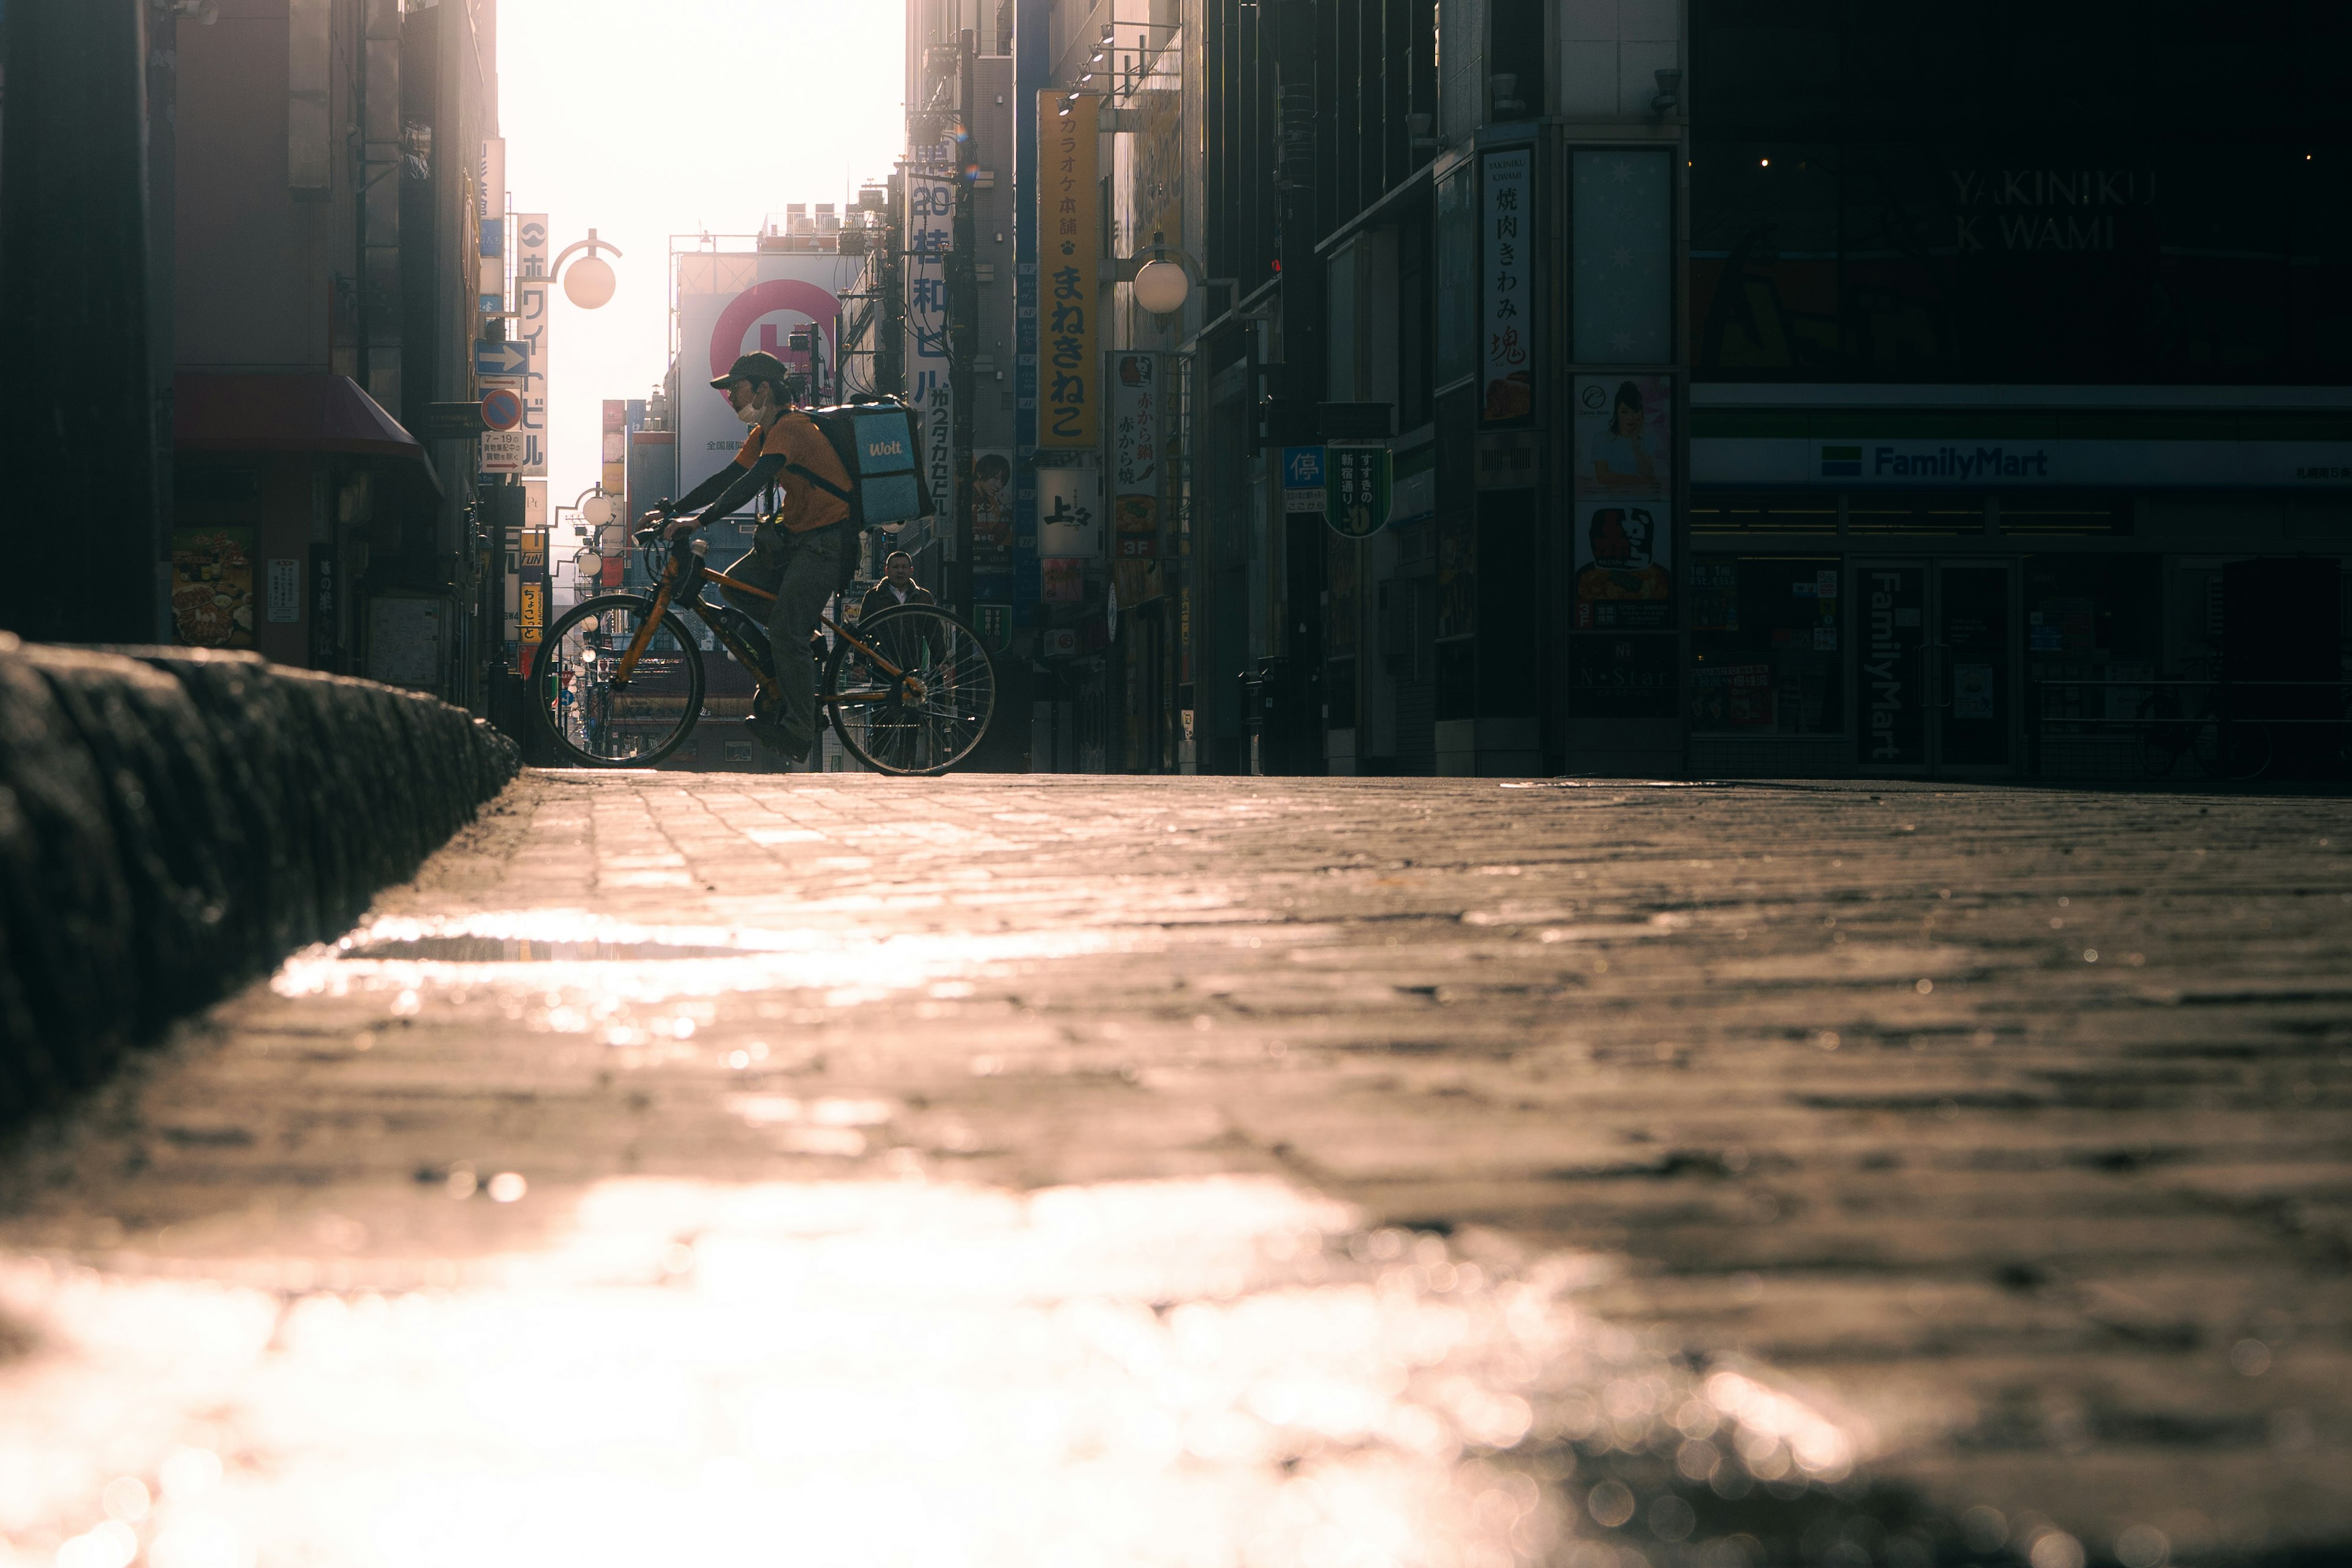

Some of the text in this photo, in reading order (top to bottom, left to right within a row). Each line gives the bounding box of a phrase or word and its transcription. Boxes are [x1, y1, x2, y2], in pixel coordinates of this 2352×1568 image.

[1060, 118, 1077, 236] カラオケ本舗
[1488, 159, 1526, 170] YAKINIKU
[1493, 172, 1521, 182] KIWAMI
[1496, 187, 1517, 320] 焼肉きわみ
[1954, 214, 2115, 251] KWAMI
[1050, 265, 1084, 437] まねきねこ
[870, 440, 902, 456] Wolt
[1118, 417, 1135, 484] 赤から焼
[1137, 393, 1153, 461] 赤から鍋
[1290, 453, 1319, 481] 停
[1341, 454, 1354, 504] 新宿通り
[1360, 456, 1373, 503] すすきの
[1875, 447, 2048, 480] FamilyMart
[1123, 541, 1148, 554] 3F
[1864, 573, 1902, 760] FamilyMart
